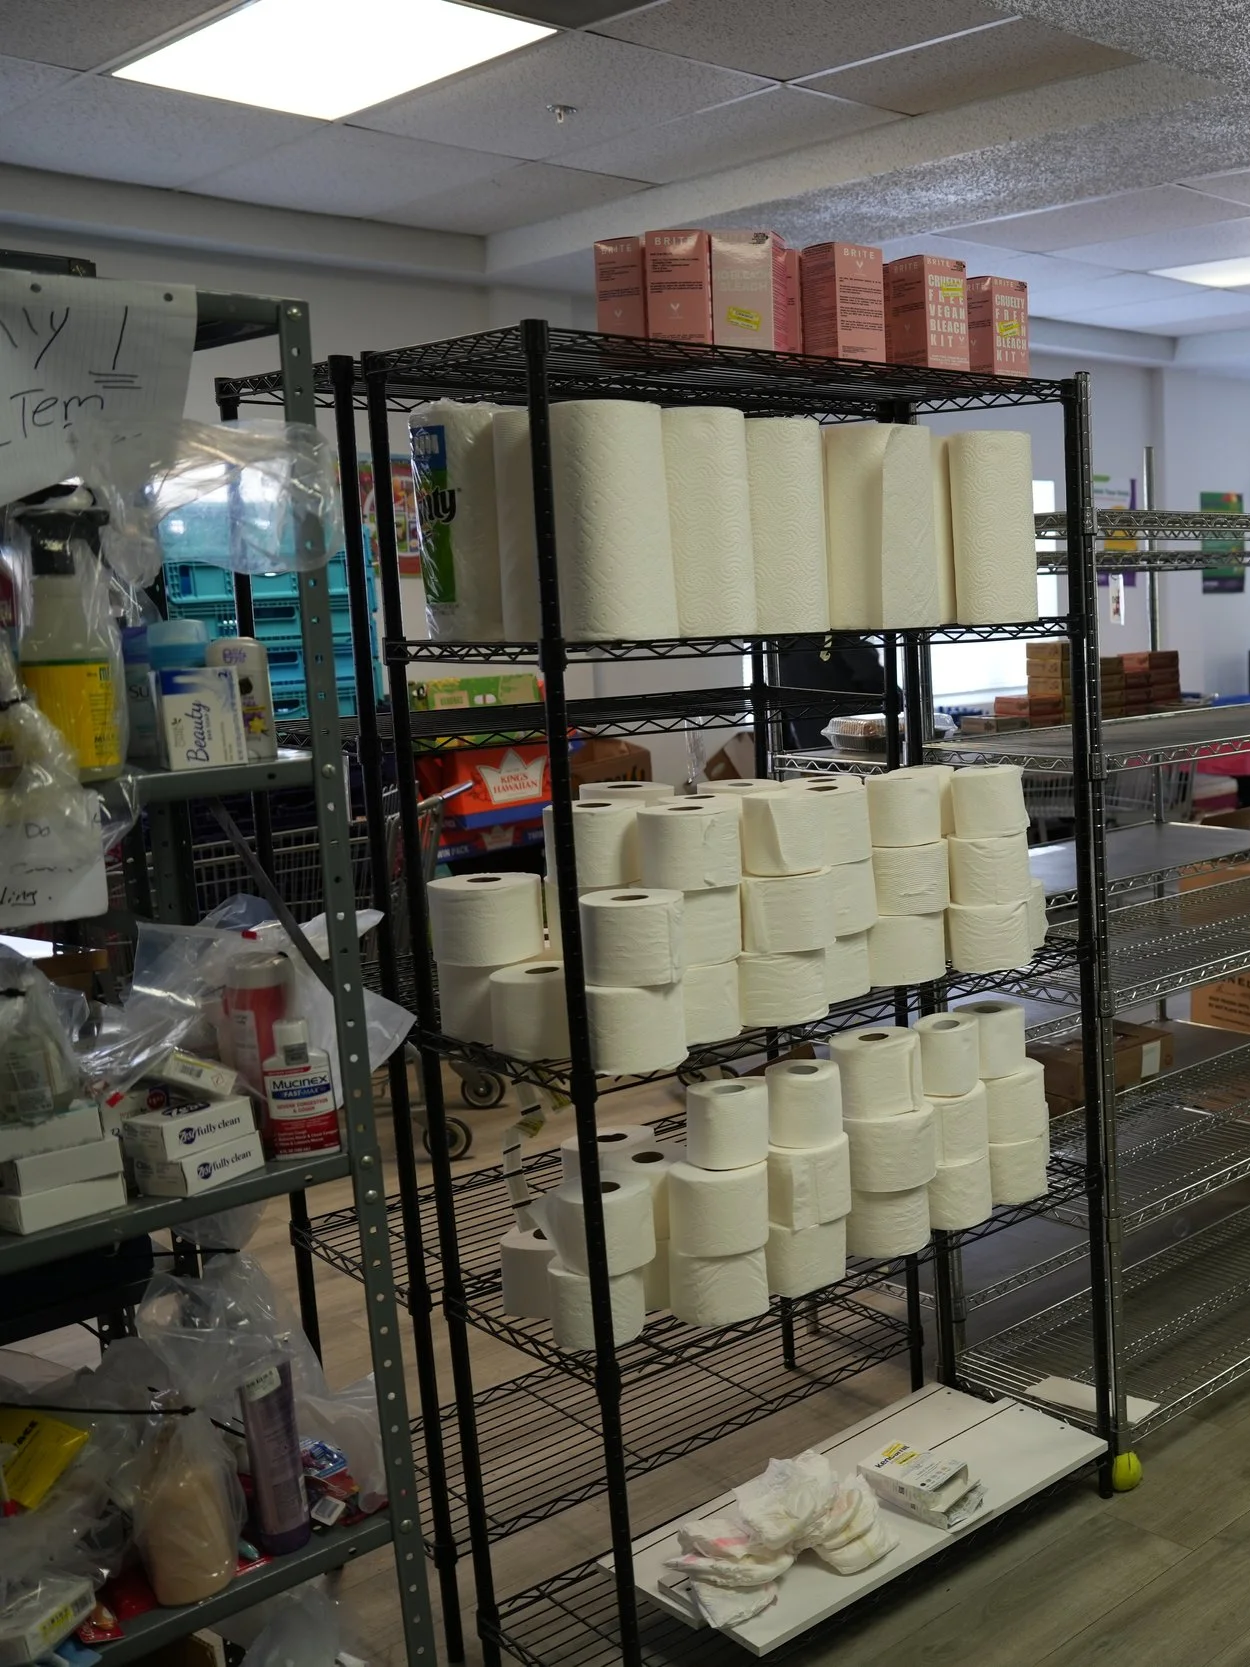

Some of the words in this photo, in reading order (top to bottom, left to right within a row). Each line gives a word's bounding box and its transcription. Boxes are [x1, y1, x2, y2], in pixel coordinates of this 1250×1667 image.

[843, 247, 875, 260] BRITE
[927, 257, 951, 268] BRITE
[995, 294, 1025, 309] CRUELTY
[929, 303, 966, 320] VEGAN
[995, 307, 1025, 323] FREE
[929, 318, 967, 335] BLEACH
[931, 333, 954, 348] KIT
[996, 335, 1027, 351] BLEACH
[996, 350, 1016, 363] KIT
[10, 388, 104, 438] Tem
[184, 700, 210, 762] Beauty
[493, 780, 538, 794] HAWAIIAN
[437, 847, 451, 860] WIN
[197, 1124, 217, 1137] fully
[218, 1116, 241, 1129] clean
[213, 1157, 231, 1171] fully
[231, 1150, 252, 1163] clean
